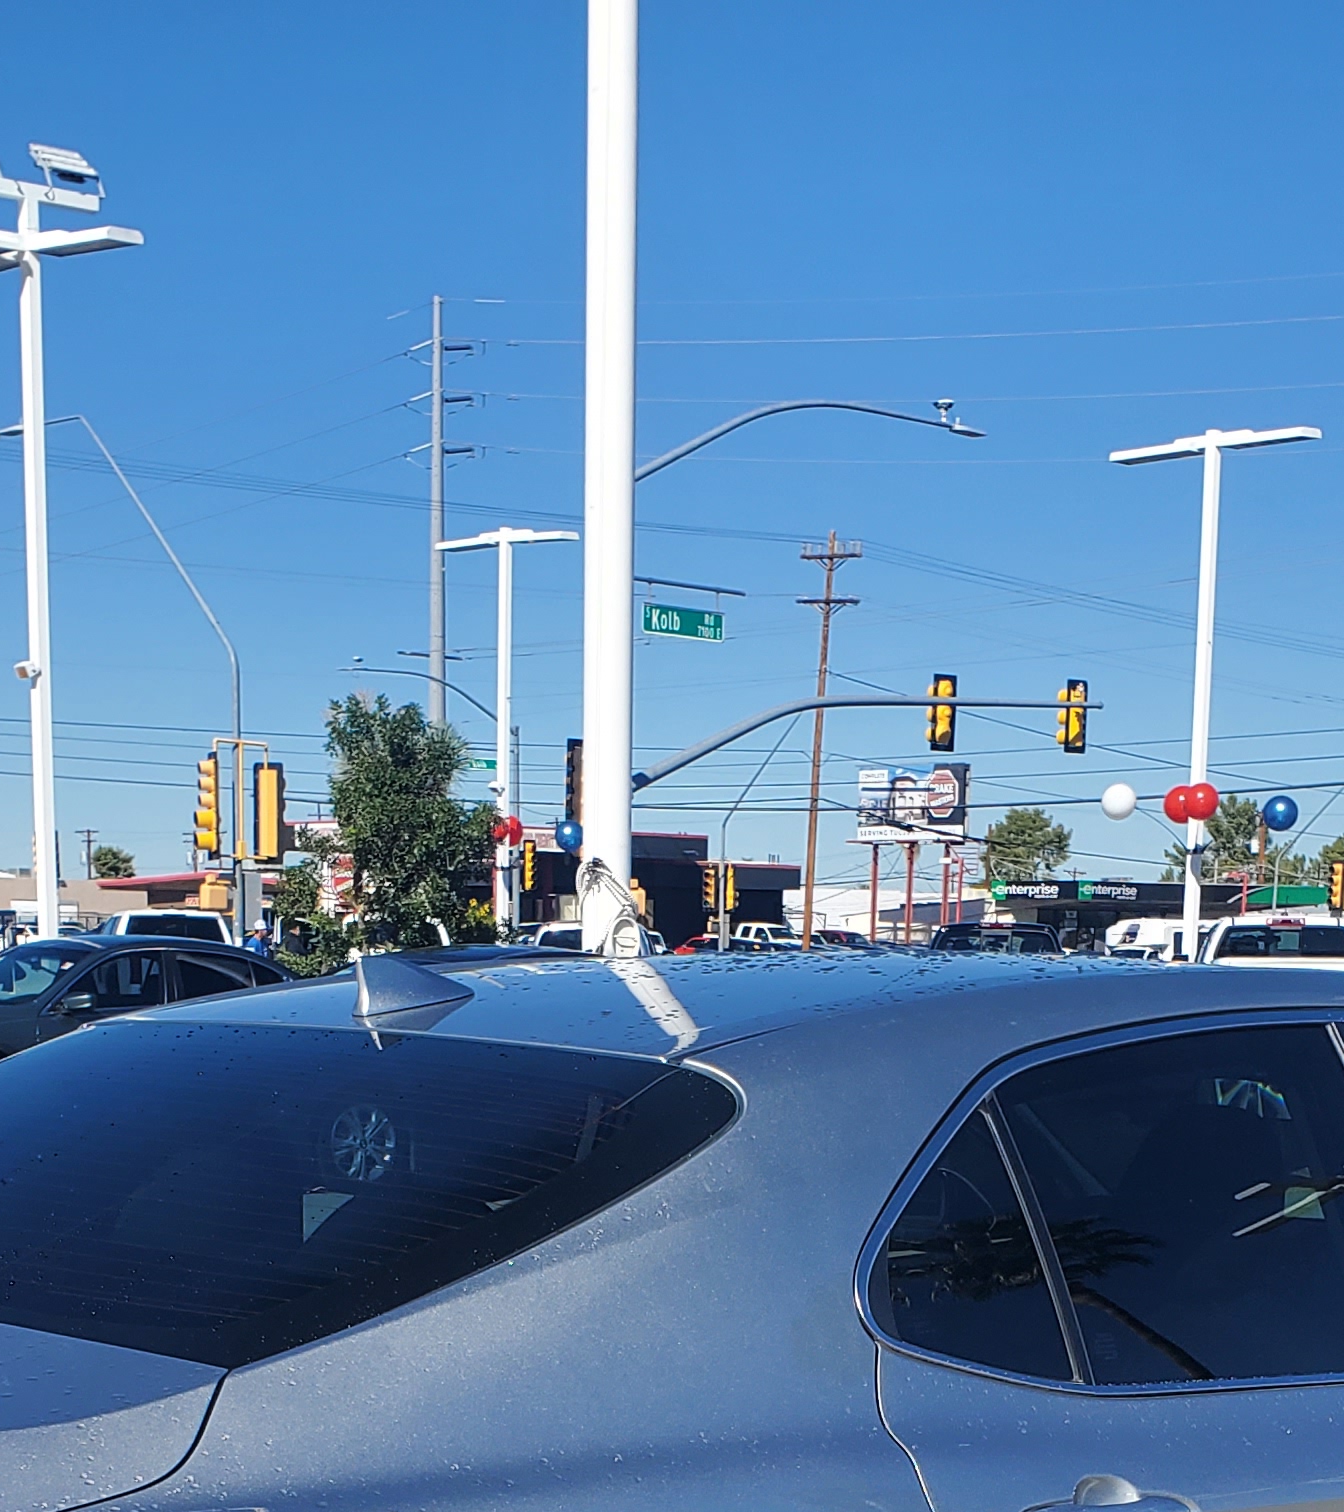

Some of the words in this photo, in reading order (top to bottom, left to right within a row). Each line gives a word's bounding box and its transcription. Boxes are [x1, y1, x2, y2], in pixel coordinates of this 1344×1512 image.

[651, 608, 681, 631] Kolb
[704, 613, 715, 626] Rd
[991, 883, 1059, 898] enterprise
[1080, 884, 1138, 898] enterprise
